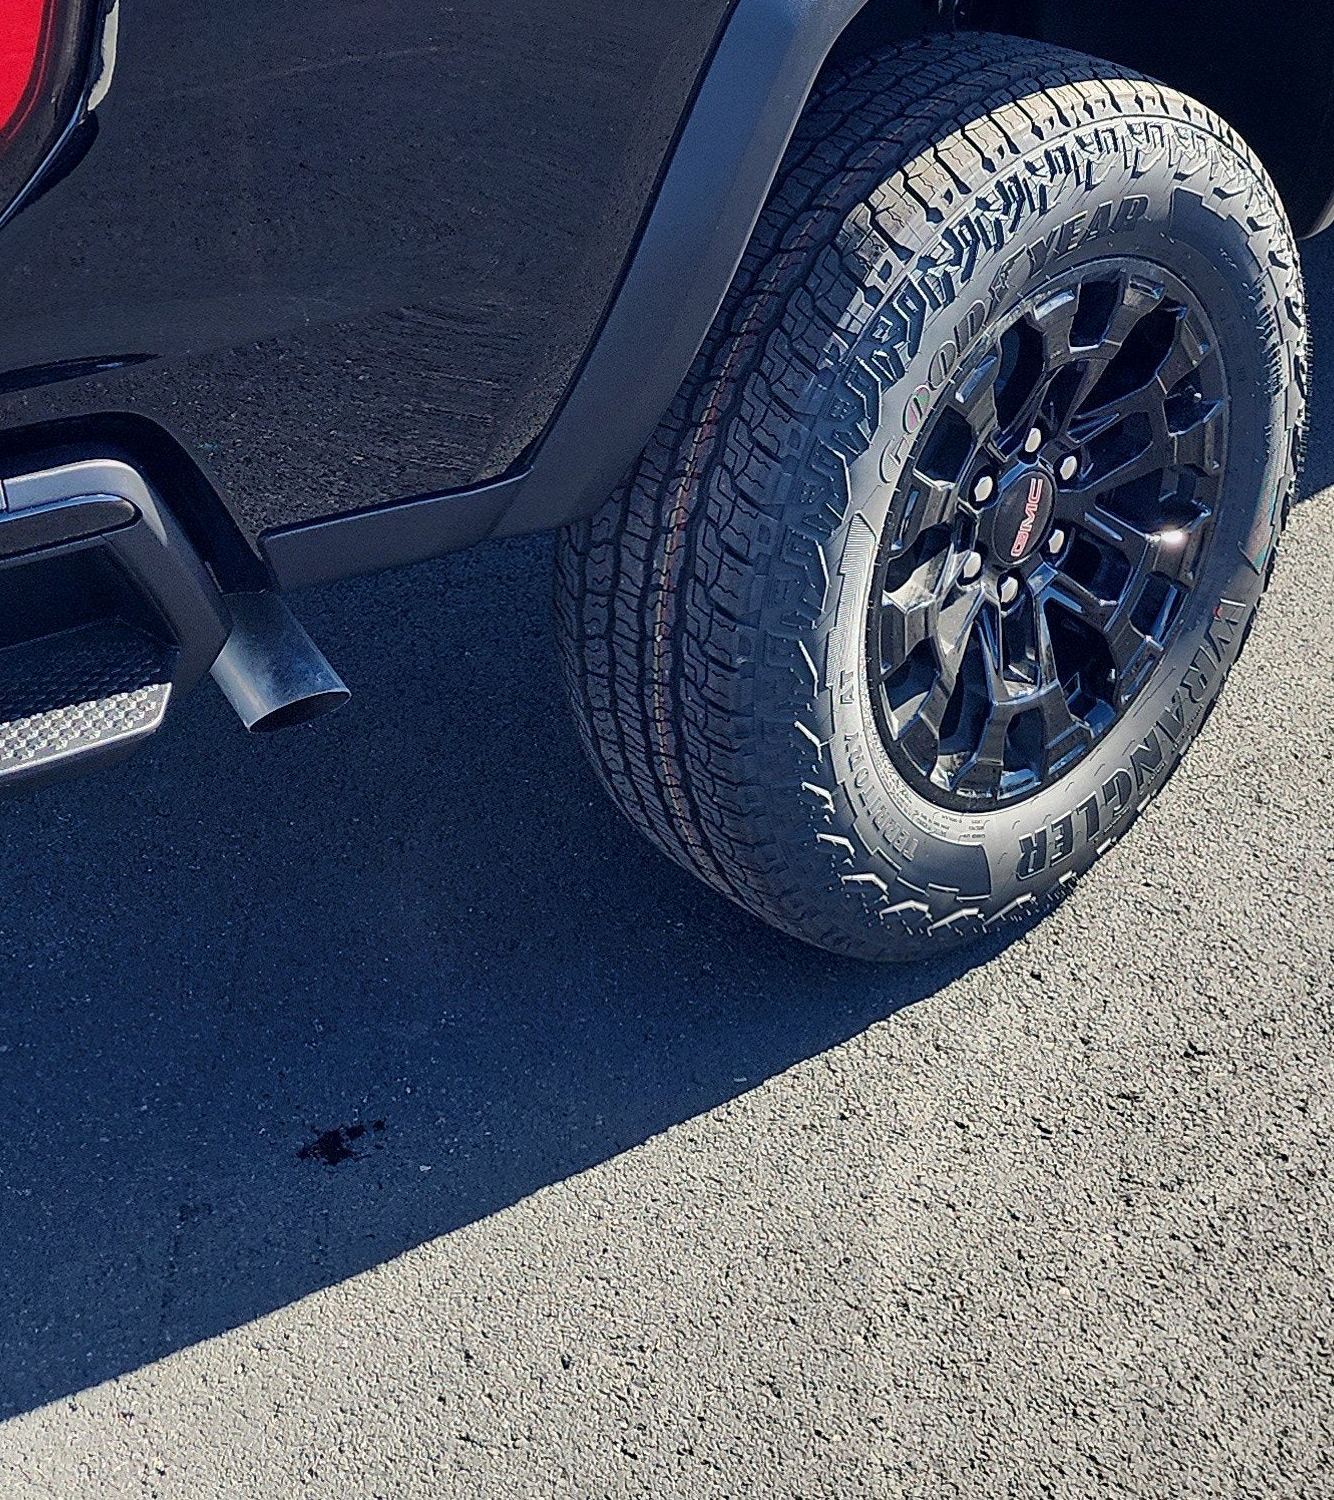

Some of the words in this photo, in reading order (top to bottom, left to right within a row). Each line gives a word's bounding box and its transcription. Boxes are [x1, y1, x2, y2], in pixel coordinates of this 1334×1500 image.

[879, 195, 1149, 484] GOODYEAR
[1011, 477, 1043, 557] GMC
[845, 731, 919, 862] TERRITORY
[1017, 598, 1247, 880] WRANGLER
